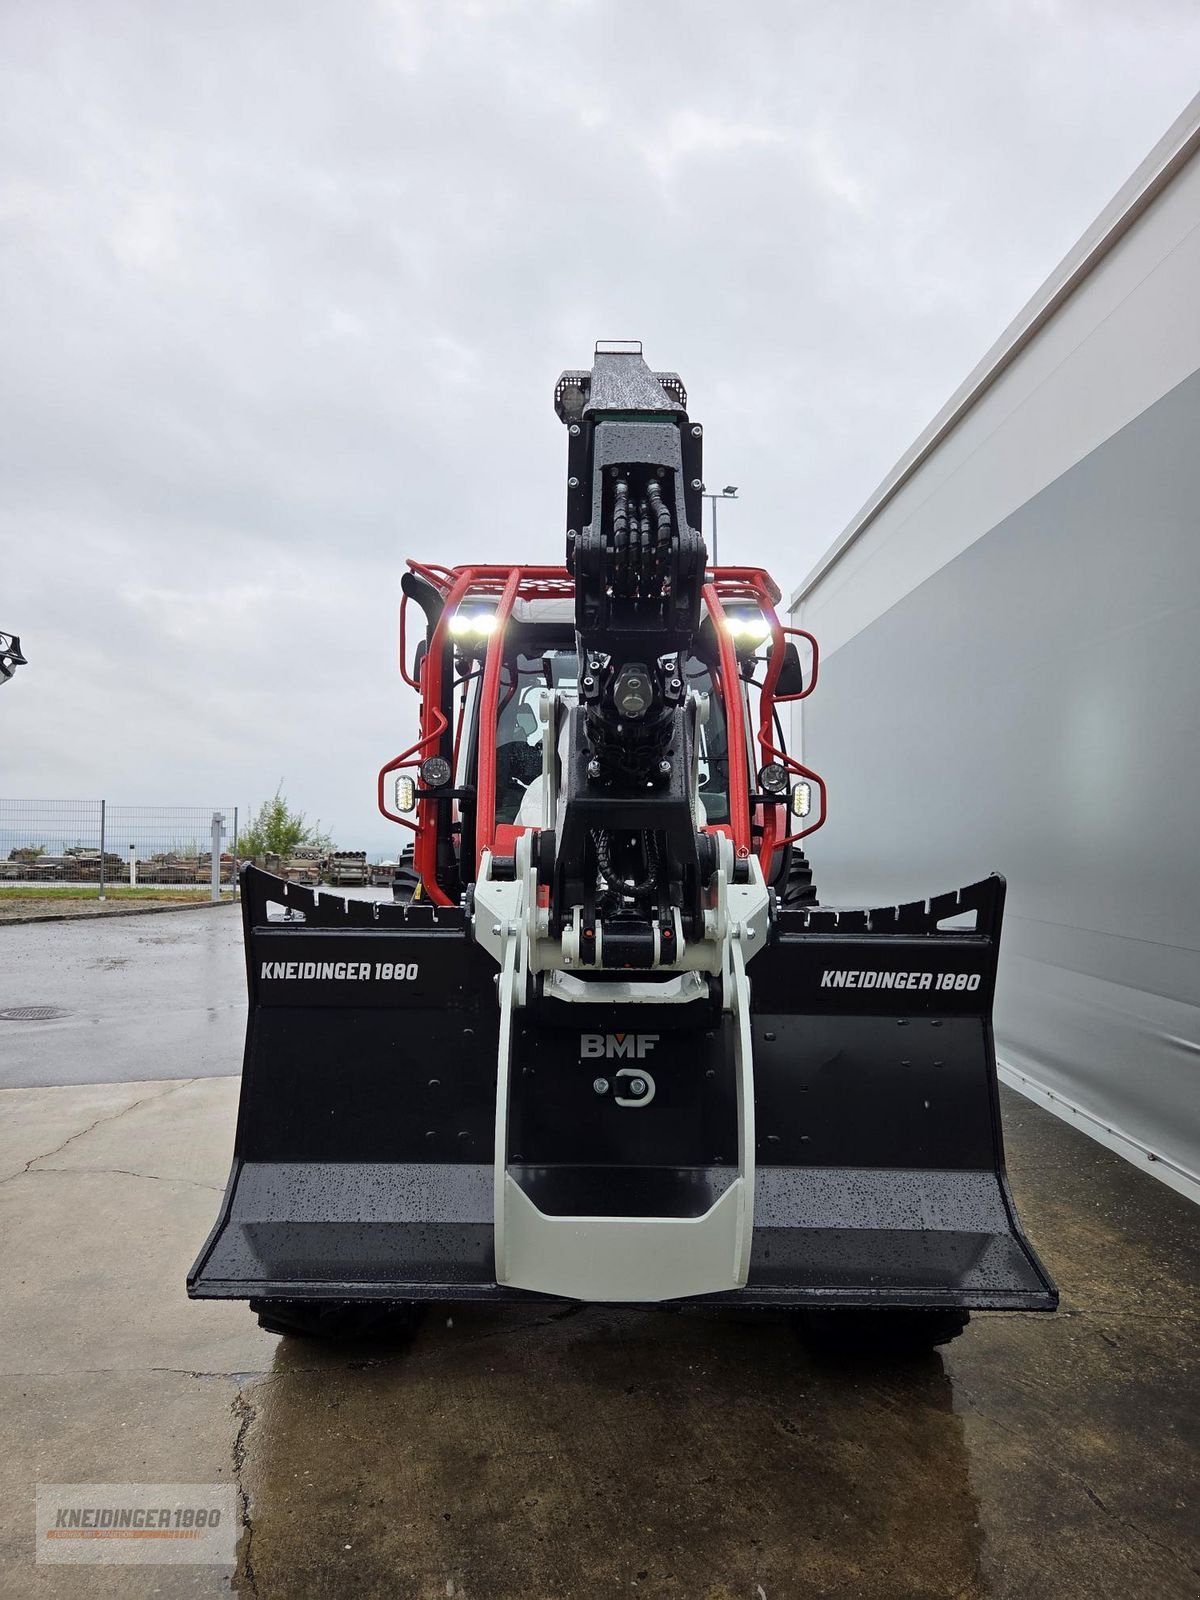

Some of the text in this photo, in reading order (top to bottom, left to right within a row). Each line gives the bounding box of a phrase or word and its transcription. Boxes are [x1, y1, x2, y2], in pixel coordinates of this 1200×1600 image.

[261, 962, 419, 980] KNEIDINGER 1880
[820, 970, 981, 991] KNEIDINGER 1880
[580, 1033, 660, 1059] BMF
